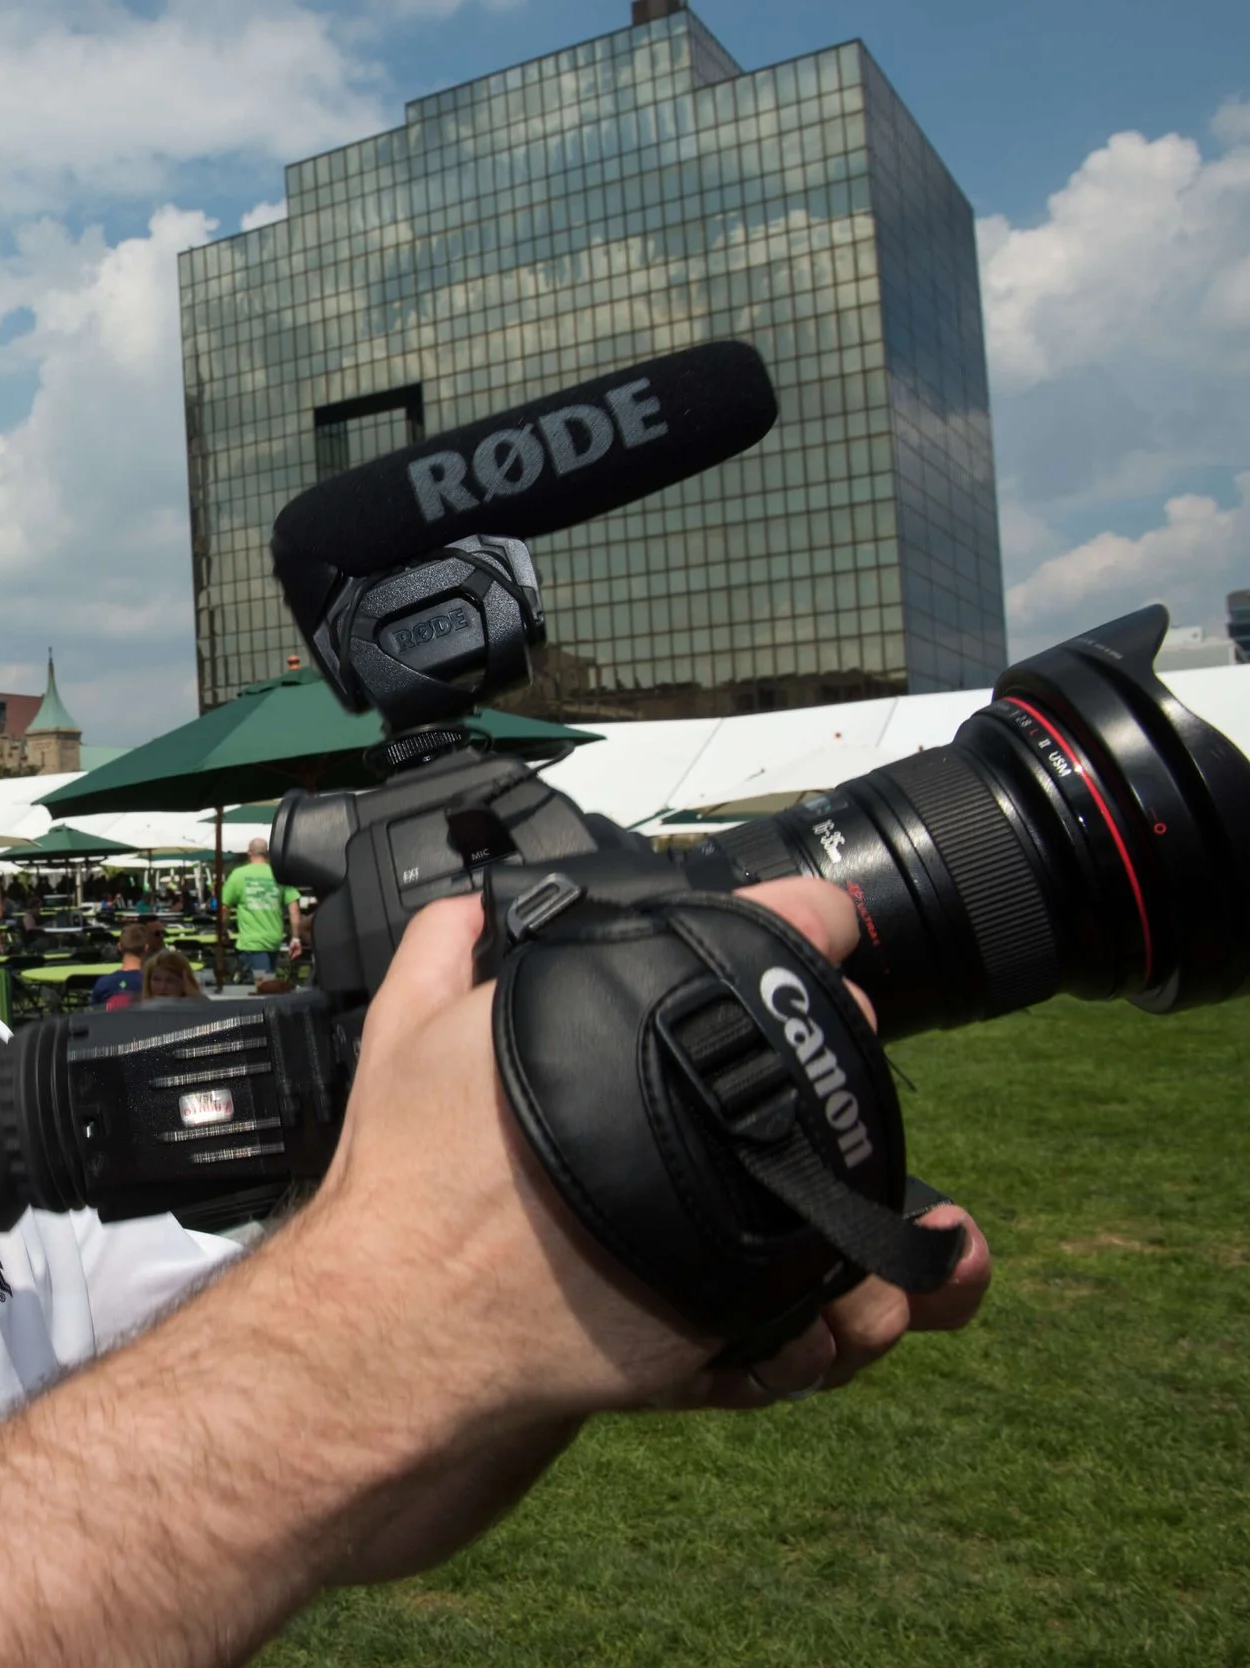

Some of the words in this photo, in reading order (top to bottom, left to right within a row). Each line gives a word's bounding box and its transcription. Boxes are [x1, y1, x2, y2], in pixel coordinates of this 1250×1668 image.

[408, 378, 669, 523] RØDE
[391, 606, 470, 653] RØDE
[1048, 750, 1072, 777] USM
[471, 848, 490, 861] MIC
[760, 966, 873, 1169] Canon
